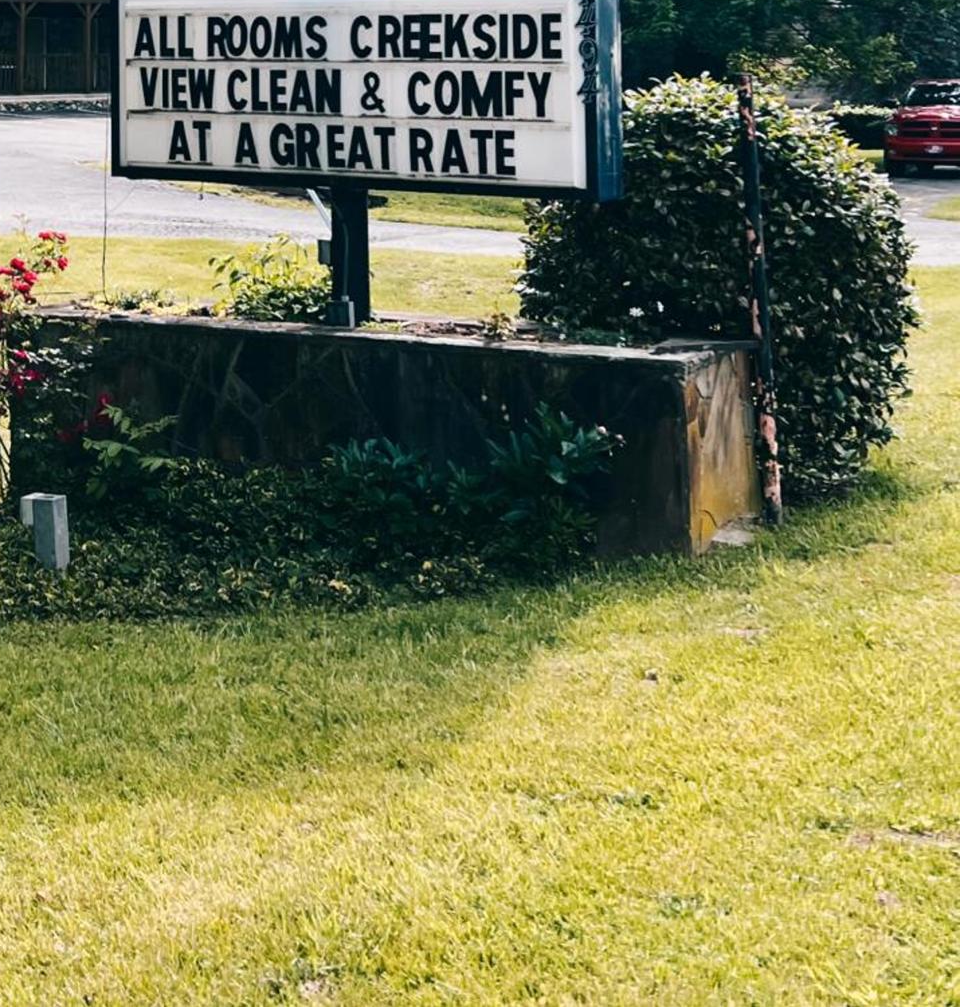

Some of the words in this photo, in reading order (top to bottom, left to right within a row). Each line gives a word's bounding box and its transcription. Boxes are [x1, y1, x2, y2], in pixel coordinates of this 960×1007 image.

[134, 15, 194, 58] ALL
[207, 15, 328, 59] ROOMS
[350, 13, 563, 60] CREEKSIDE
[140, 67, 215, 109] VIEW
[227, 67, 342, 113] CLEAN
[360, 71, 386, 113] &
[407, 70, 552, 118] COMFY
[169, 120, 212, 162] AT
[235, 122, 259, 165] A
[269, 122, 396, 171] GREAT
[409, 128, 516, 176] RATE
